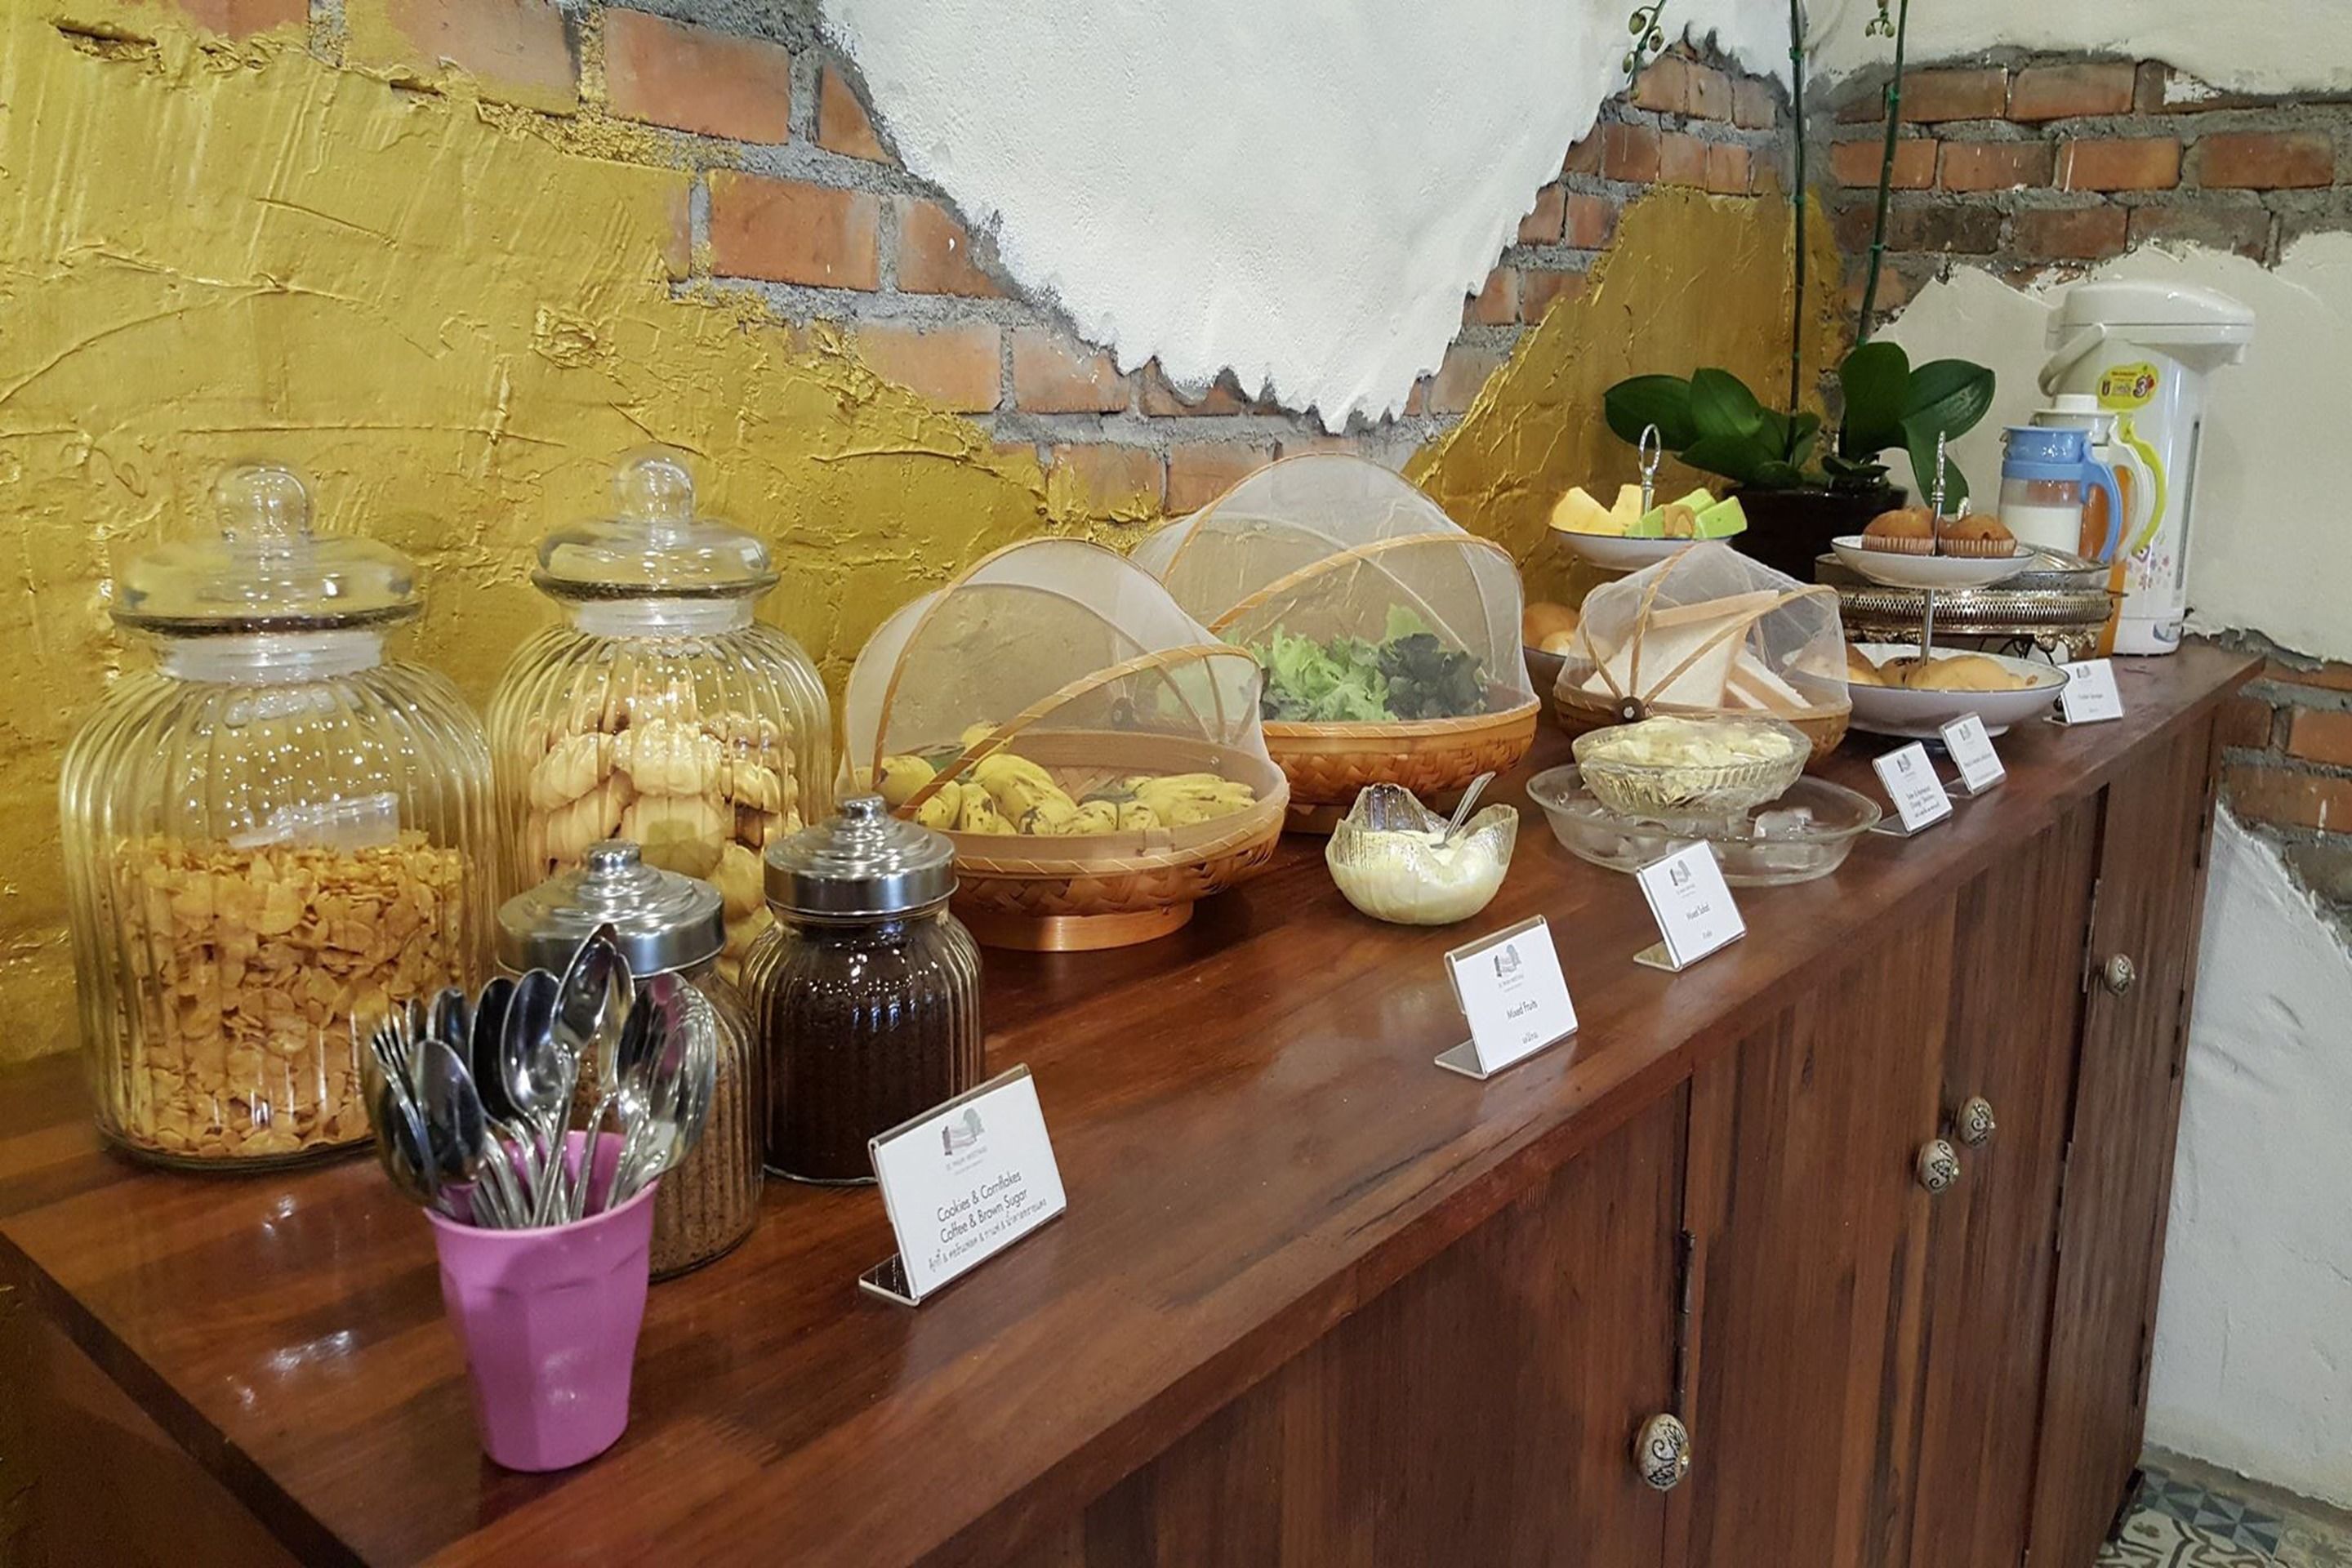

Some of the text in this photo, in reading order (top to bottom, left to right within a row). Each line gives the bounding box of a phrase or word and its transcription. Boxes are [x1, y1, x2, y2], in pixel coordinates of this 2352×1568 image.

[937, 1170, 1022, 1223] Cookies & Cornflakes
[940, 1188, 1028, 1243] Coffee & Brown Sugar
